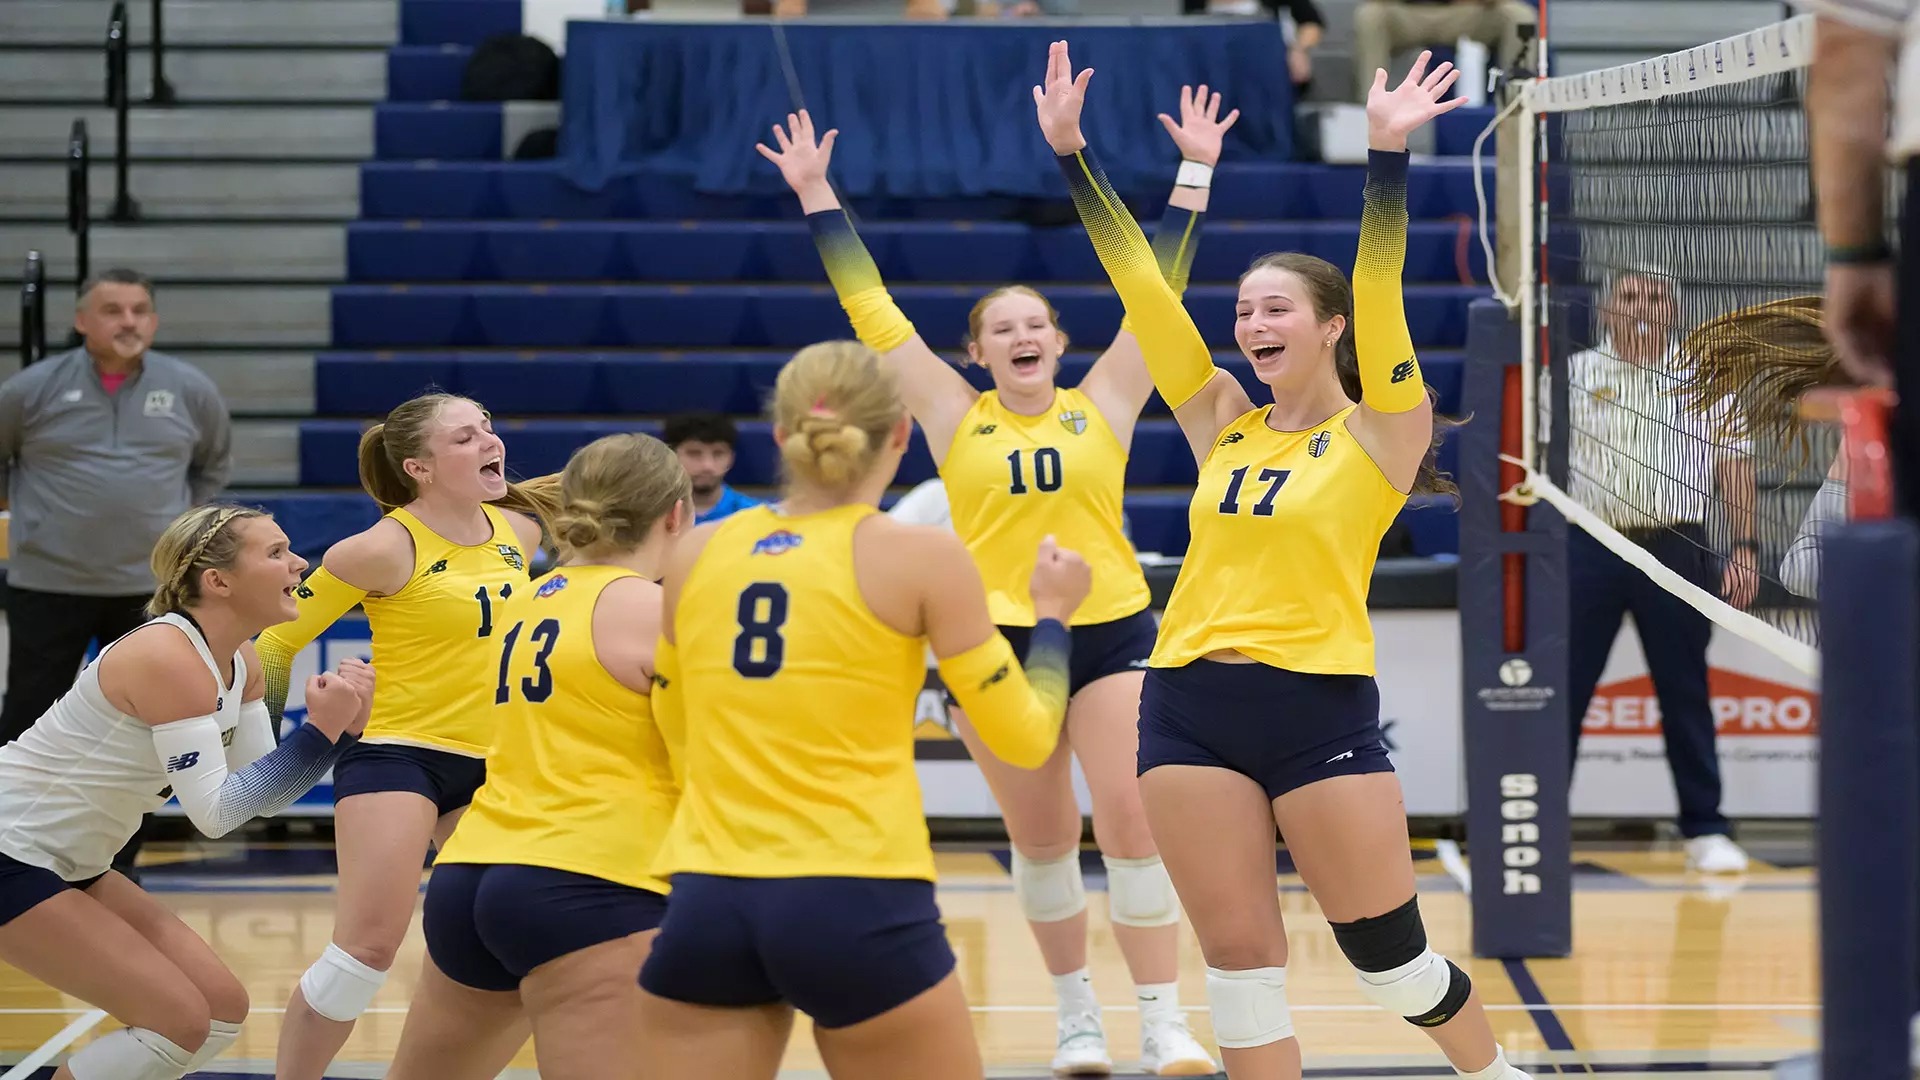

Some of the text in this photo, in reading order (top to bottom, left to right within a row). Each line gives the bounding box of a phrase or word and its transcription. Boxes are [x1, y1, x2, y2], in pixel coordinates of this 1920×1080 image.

[1007, 447, 1063, 495] 10
[1218, 464, 1292, 516] 17
[732, 581, 788, 679] 8
[495, 618, 560, 705] 13
[1582, 695, 1812, 730] SEPRO
